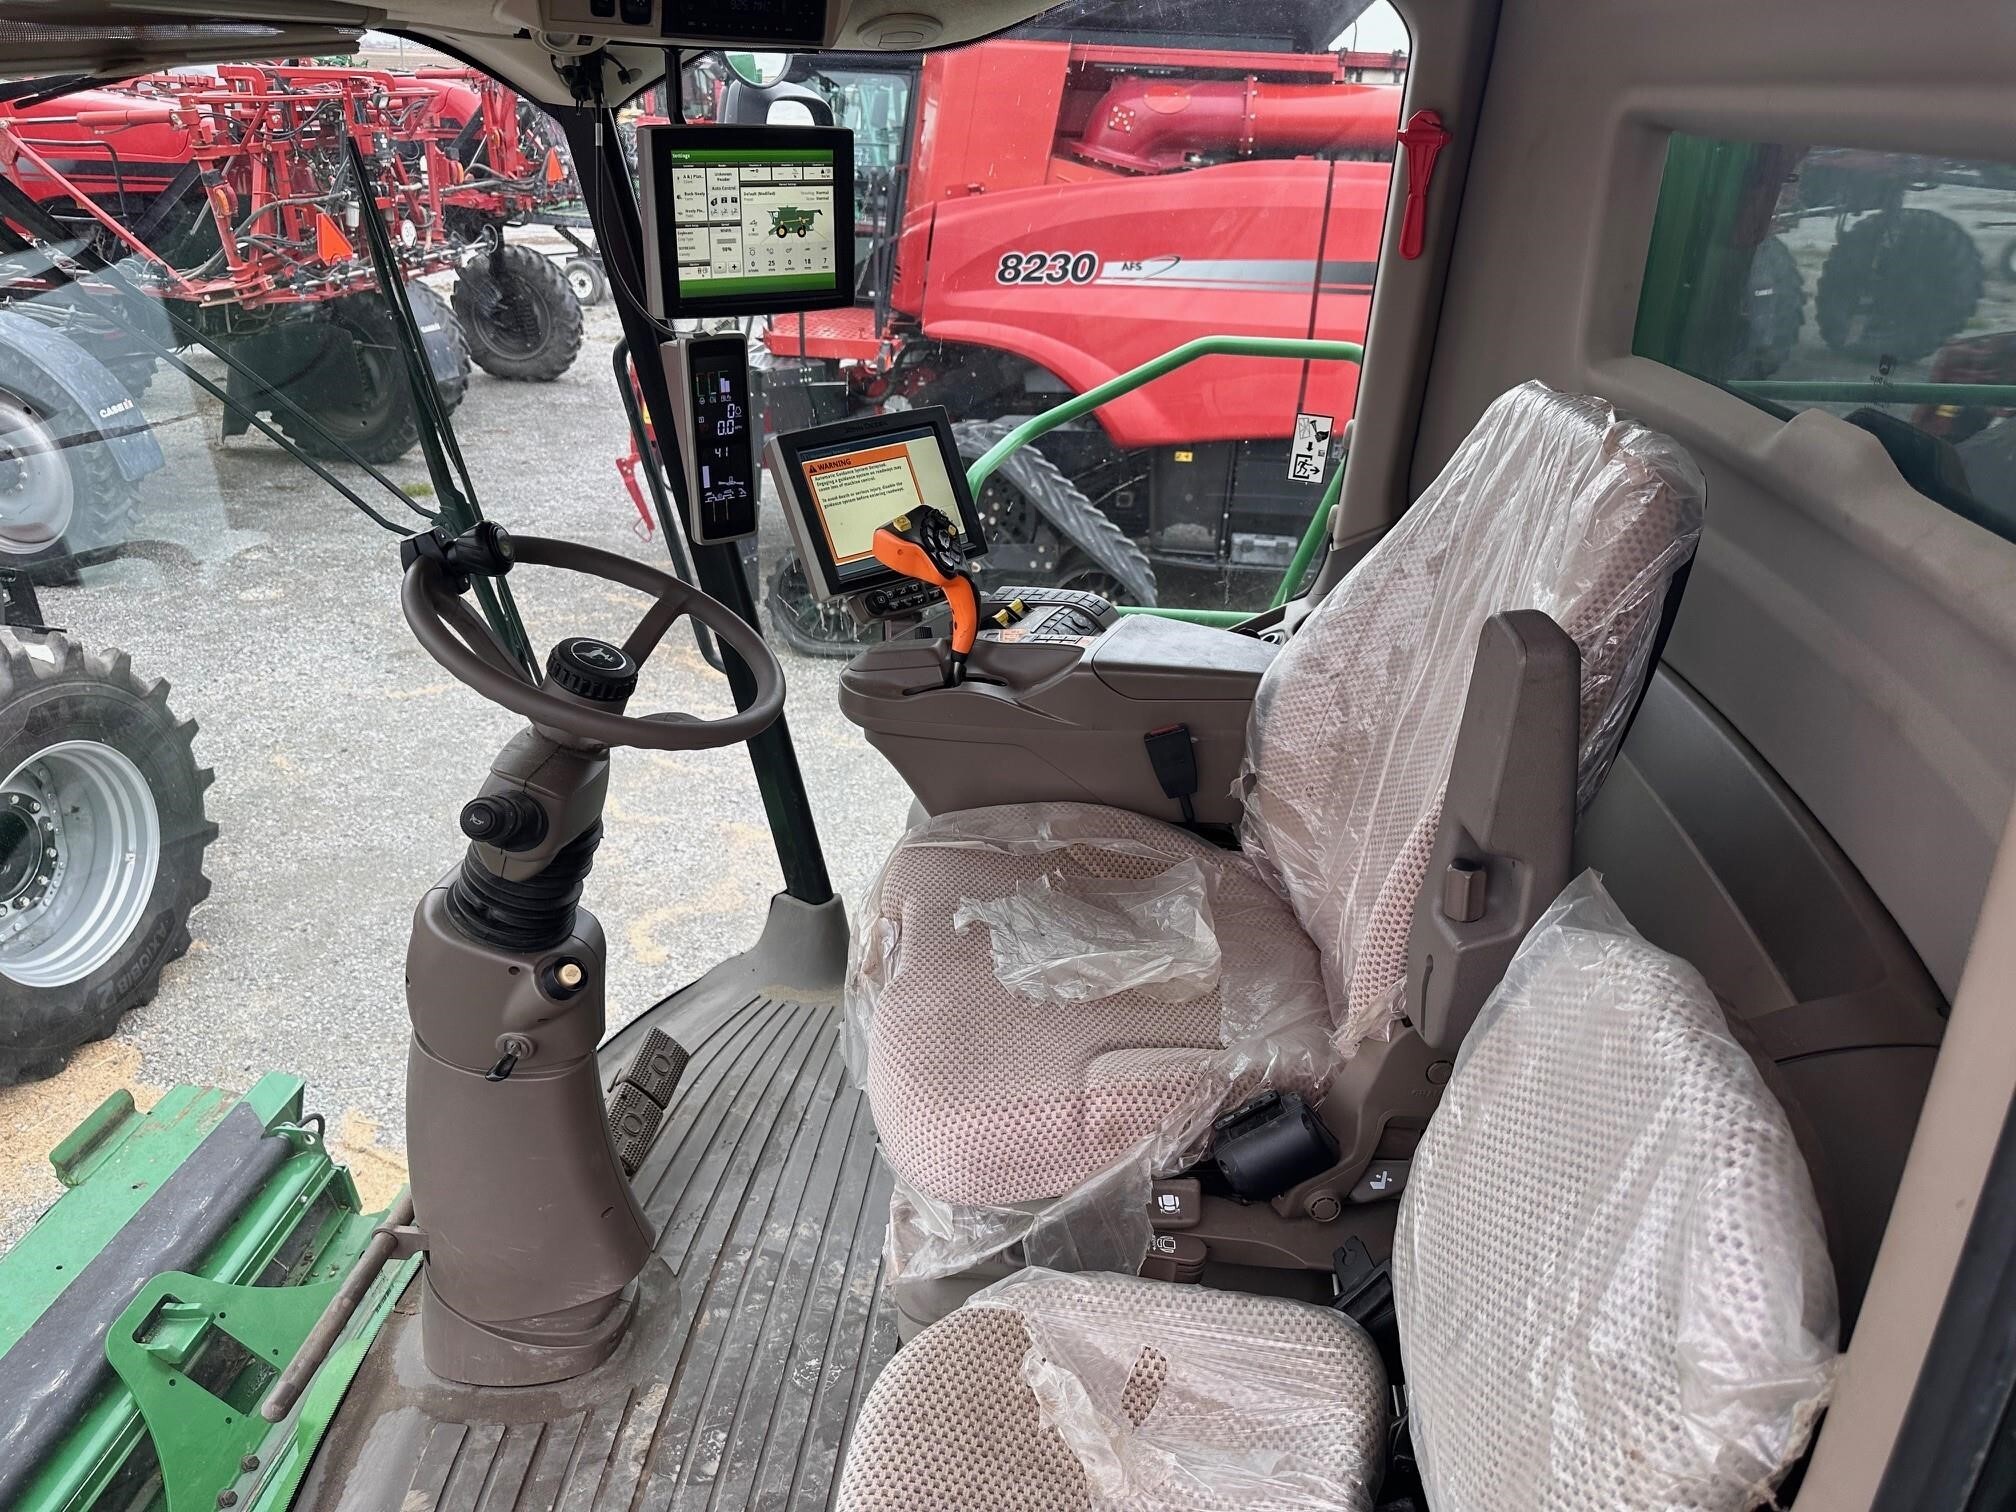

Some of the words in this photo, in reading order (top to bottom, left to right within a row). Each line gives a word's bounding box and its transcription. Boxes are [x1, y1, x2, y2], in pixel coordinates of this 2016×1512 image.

[997, 250, 1099, 286] 8230
[1121, 262, 1143, 272] AFS
[728, 404, 735, 418] 0
[718, 420, 734, 436] 0.0
[818, 459, 851, 471] WARNING
